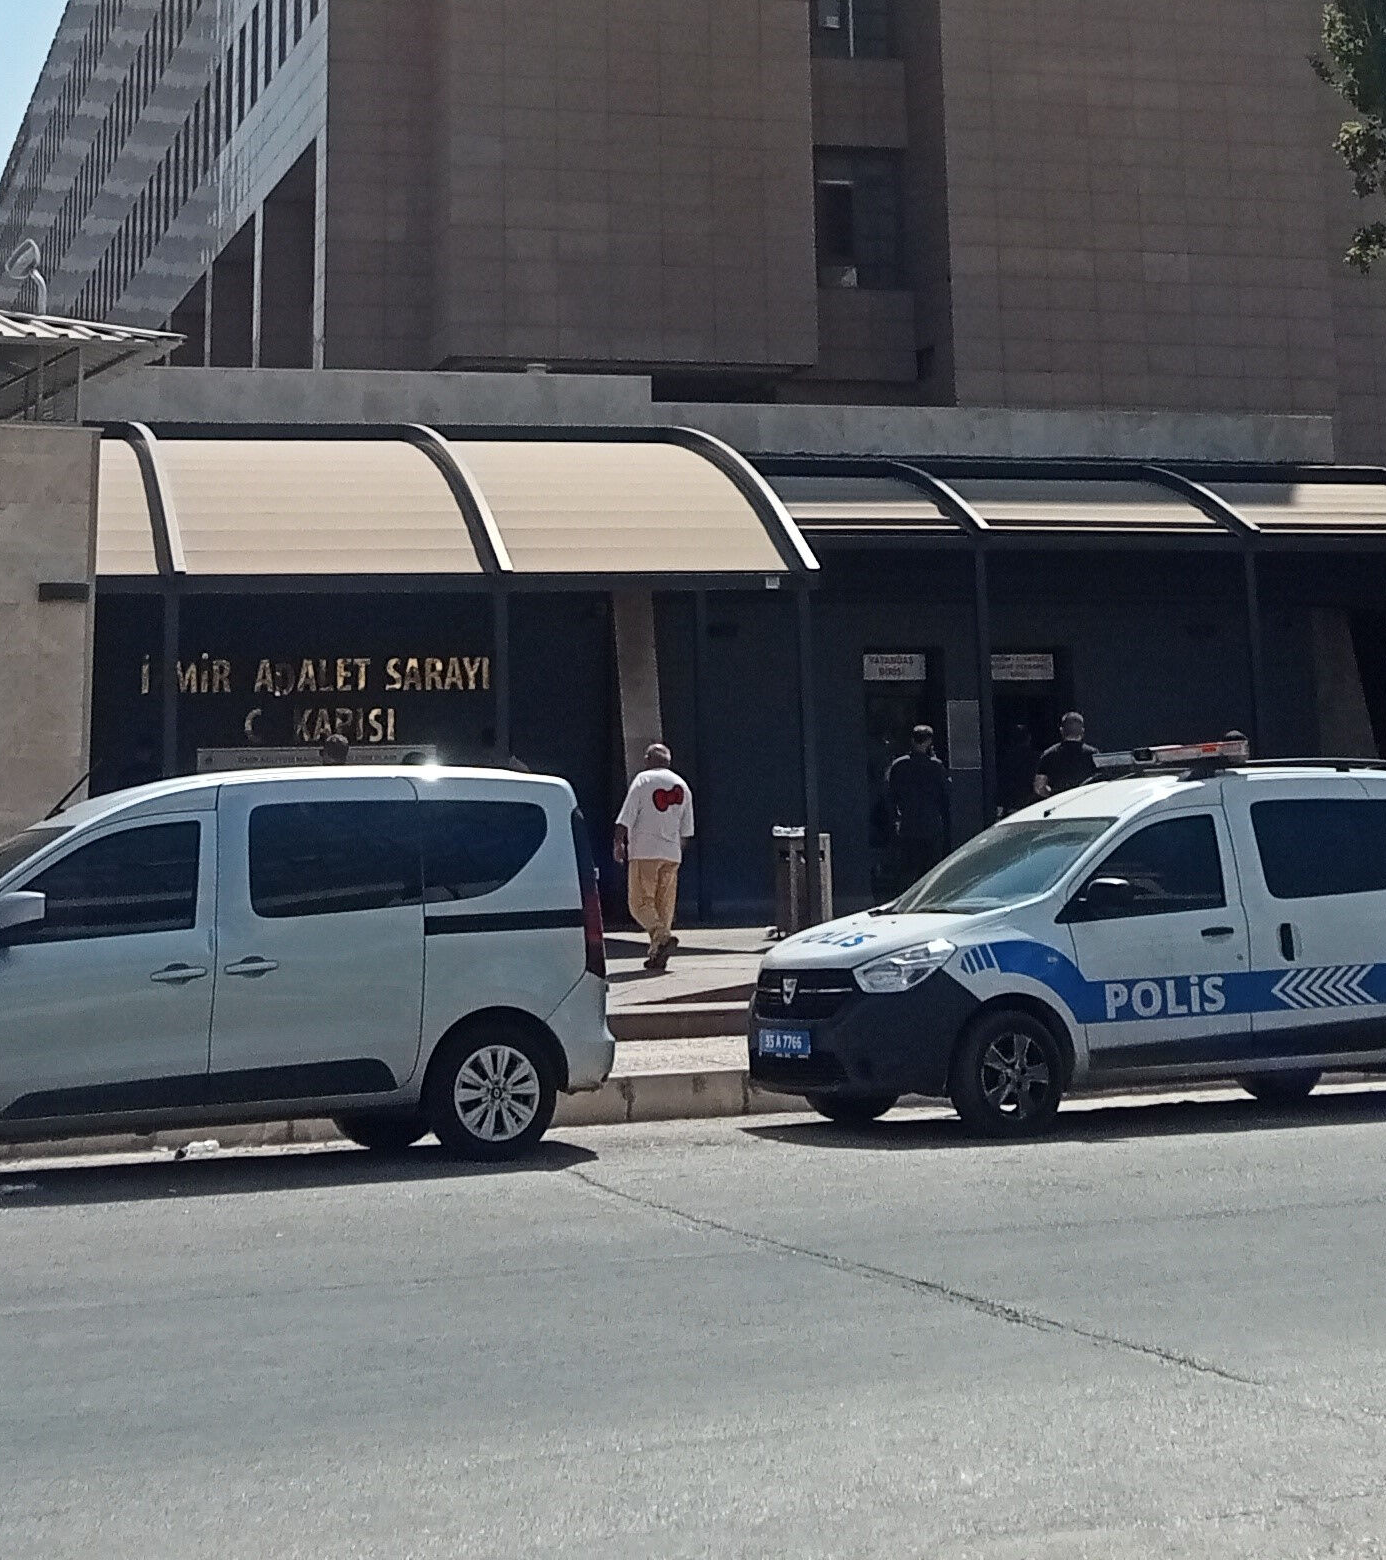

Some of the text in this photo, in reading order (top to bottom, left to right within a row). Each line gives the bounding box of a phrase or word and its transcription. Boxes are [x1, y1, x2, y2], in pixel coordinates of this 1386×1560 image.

[140, 652, 231, 694] İMİR
[385, 656, 490, 691] SARAYI
[293, 706, 396, 743] KAPISI
[1104, 975, 1226, 1020] POLİS
[775, 1034, 782, 1048] A
